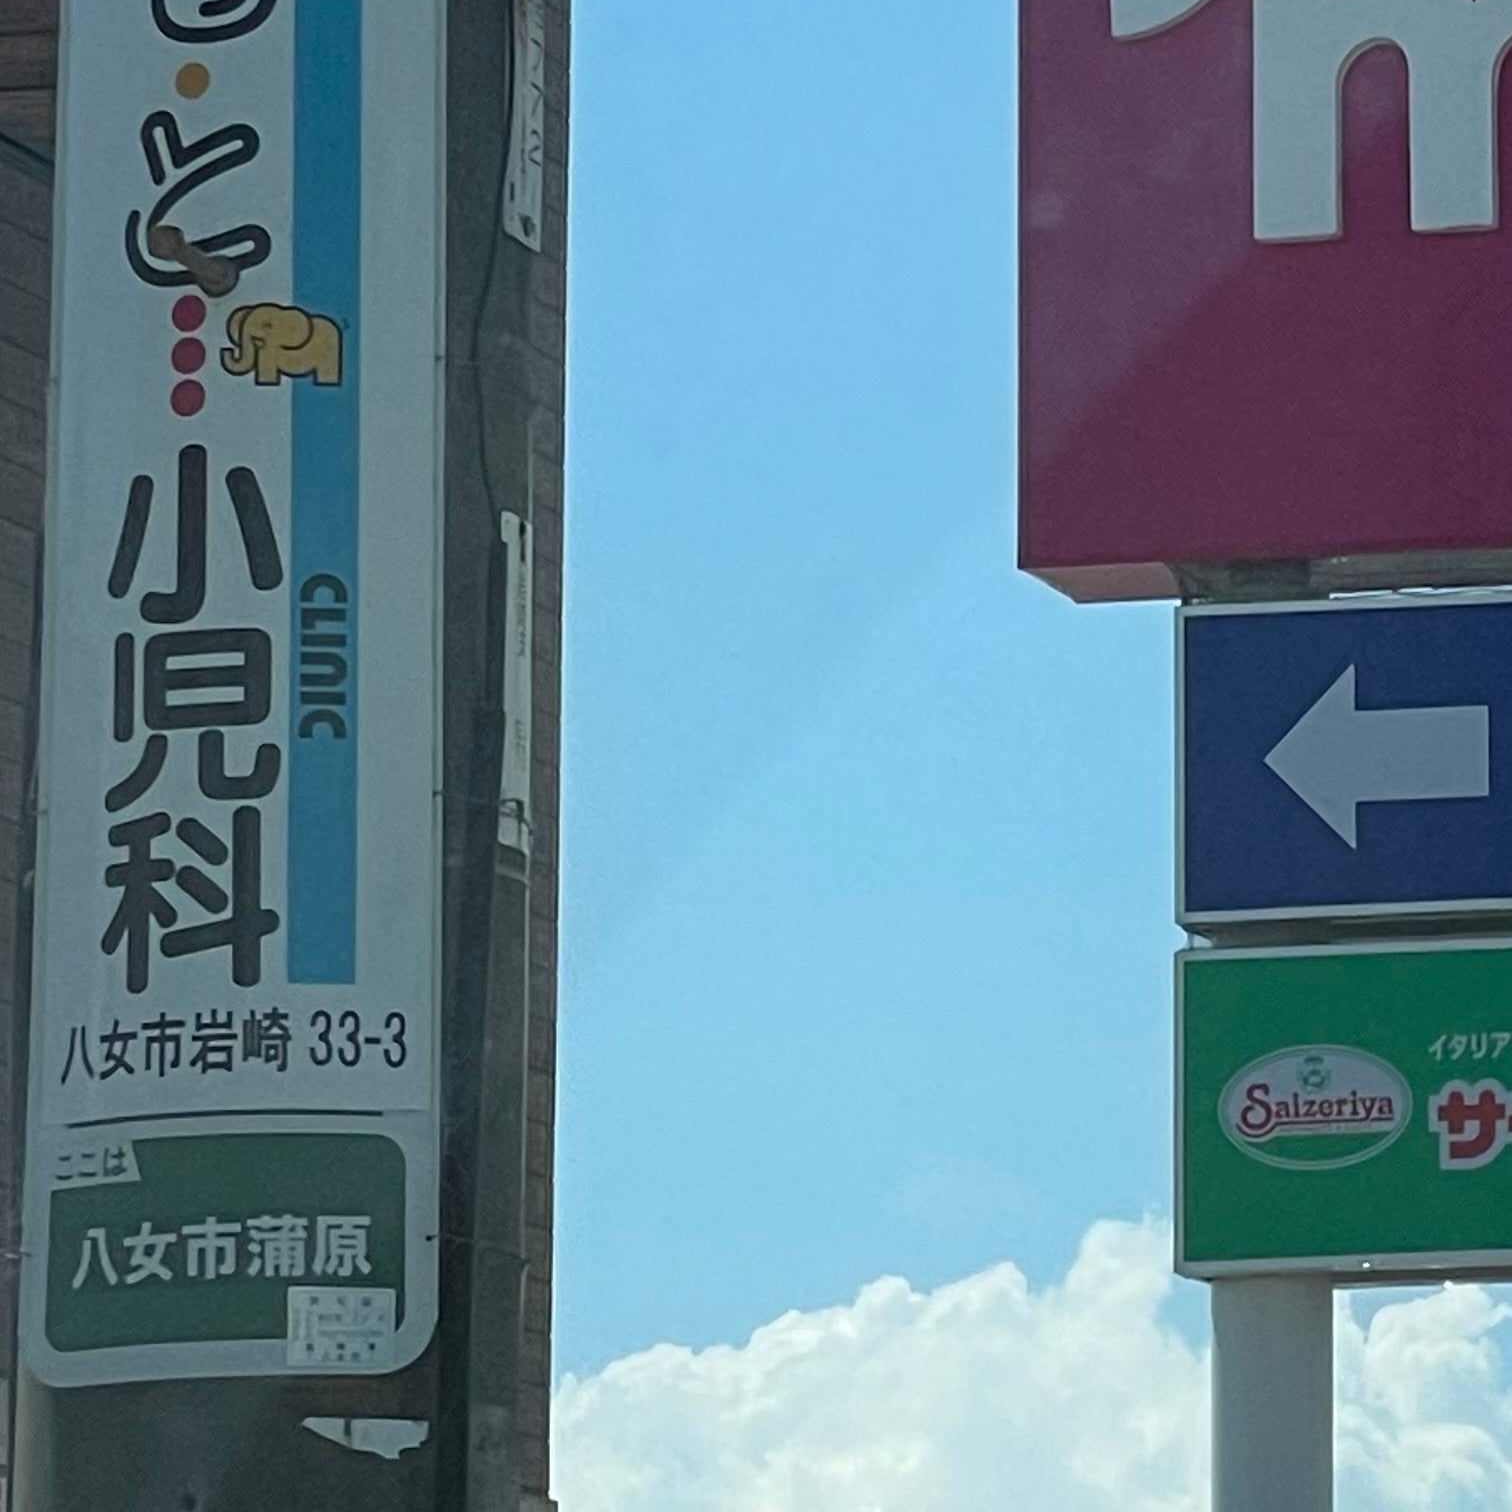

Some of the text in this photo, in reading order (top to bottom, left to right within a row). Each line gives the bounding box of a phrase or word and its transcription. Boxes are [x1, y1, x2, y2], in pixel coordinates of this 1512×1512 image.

[298, 573, 349, 740] CLINIC
[60, 1007, 408, 1086] 八女市岩崎 33-3
[55, 1146, 127, 1181] ここは
[72, 1213, 373, 1290] 八女市蒲原
